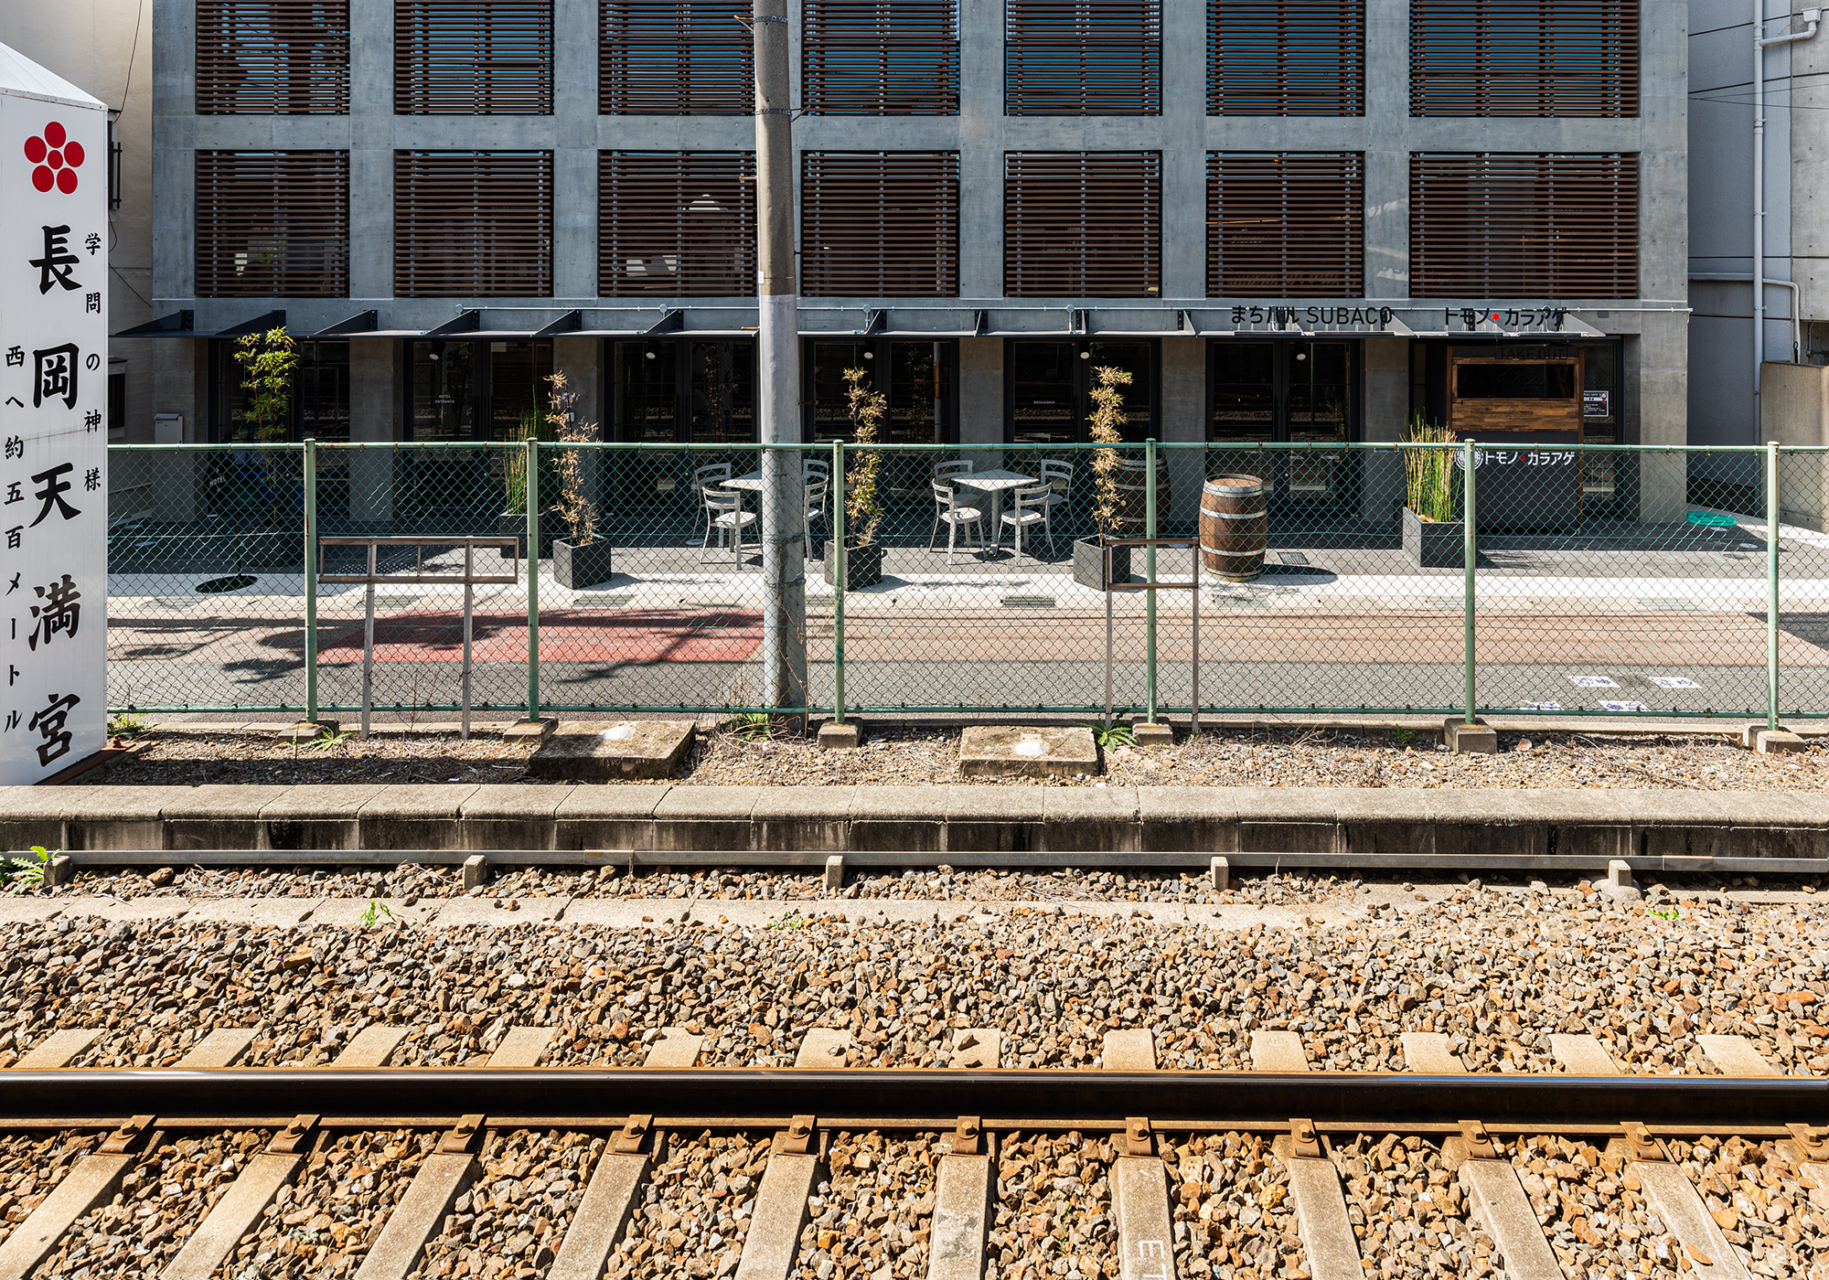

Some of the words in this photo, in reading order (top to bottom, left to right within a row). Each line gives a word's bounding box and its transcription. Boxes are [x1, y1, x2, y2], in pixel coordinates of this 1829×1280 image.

[84, 232, 102, 492] 学問の神様
[1306, 306, 1393, 325] SUBACO
[4, 345, 26, 734] 西へ約五百メートル
[28, 224, 83, 767] 長岡天満宮
